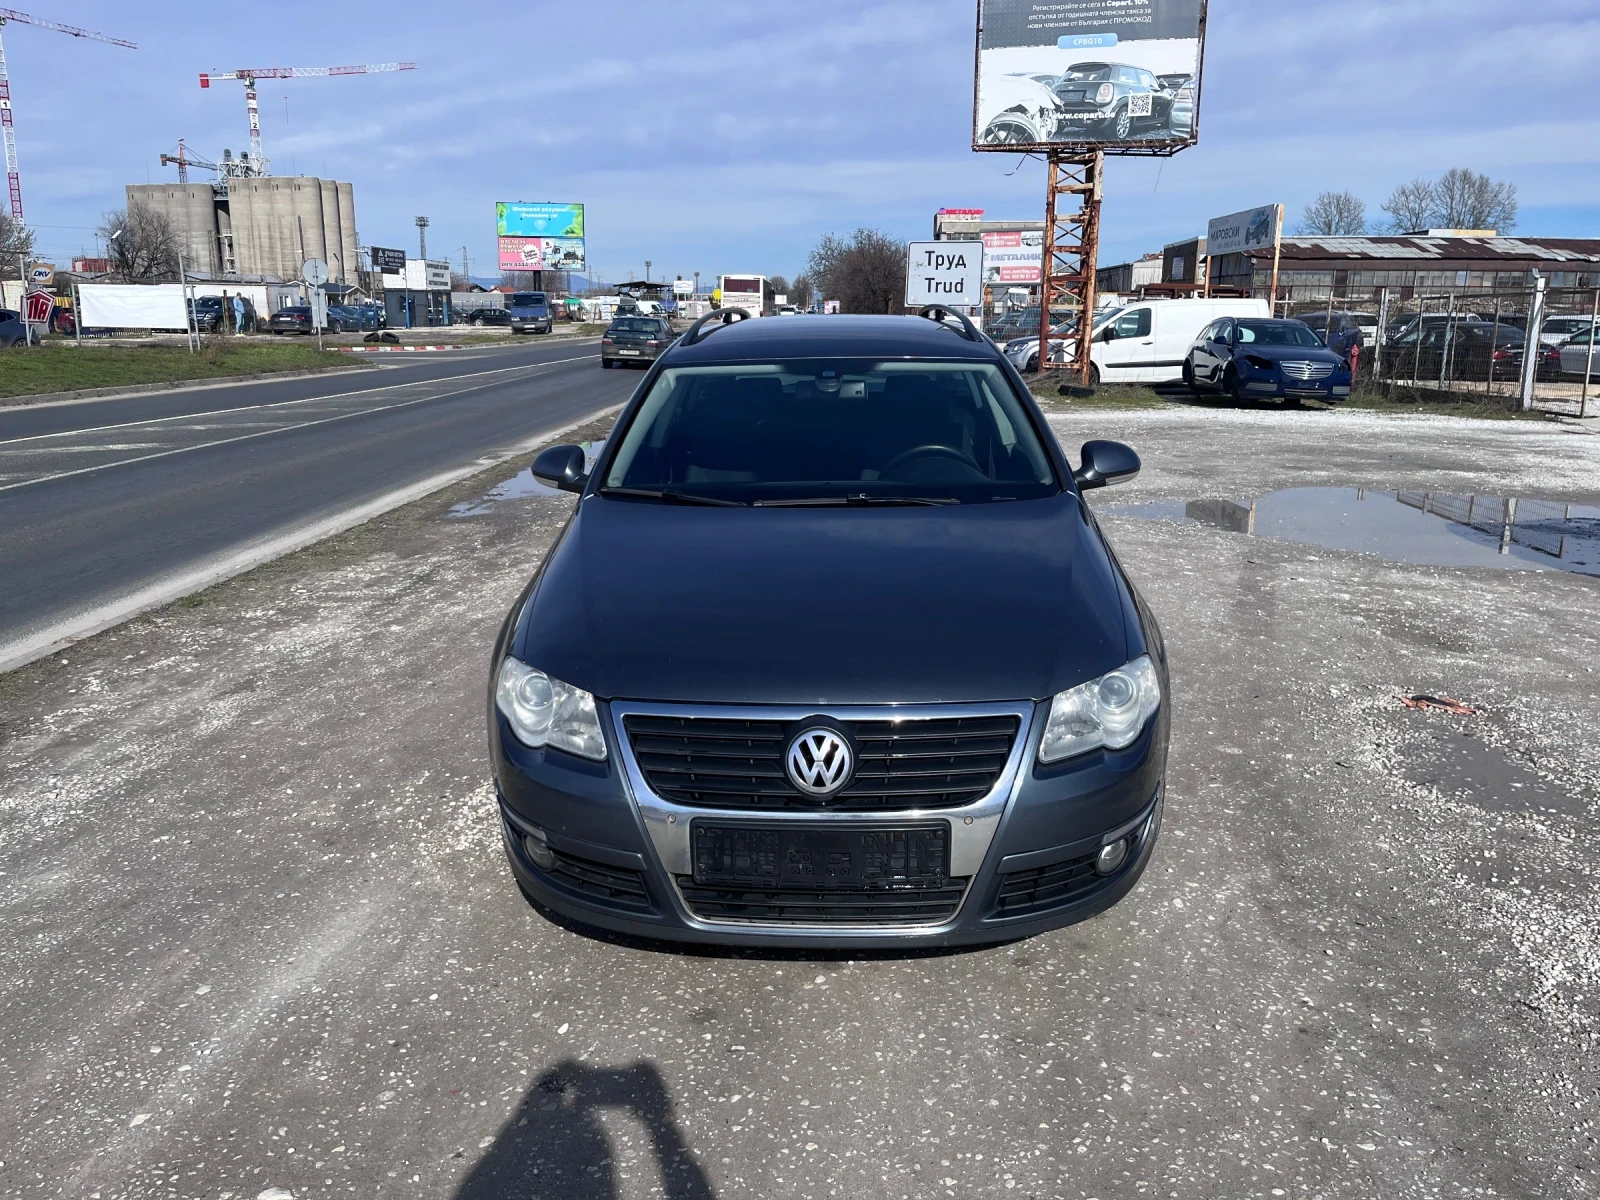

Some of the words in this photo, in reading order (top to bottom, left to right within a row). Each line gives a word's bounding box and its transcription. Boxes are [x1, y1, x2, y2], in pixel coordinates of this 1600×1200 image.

[1032, 3, 1078, 11] Регистрирайте
[1043, 20, 1070, 28] членове
[1078, 18, 1108, 26] България
[1113, 15, 1152, 24] ПРОМОКОД
[1073, 37, 1103, 46] CPBG10
[925, 251, 967, 270] Труд
[990, 253, 1042, 262] МЕТАЛИК
[925, 278, 964, 293] Trud
